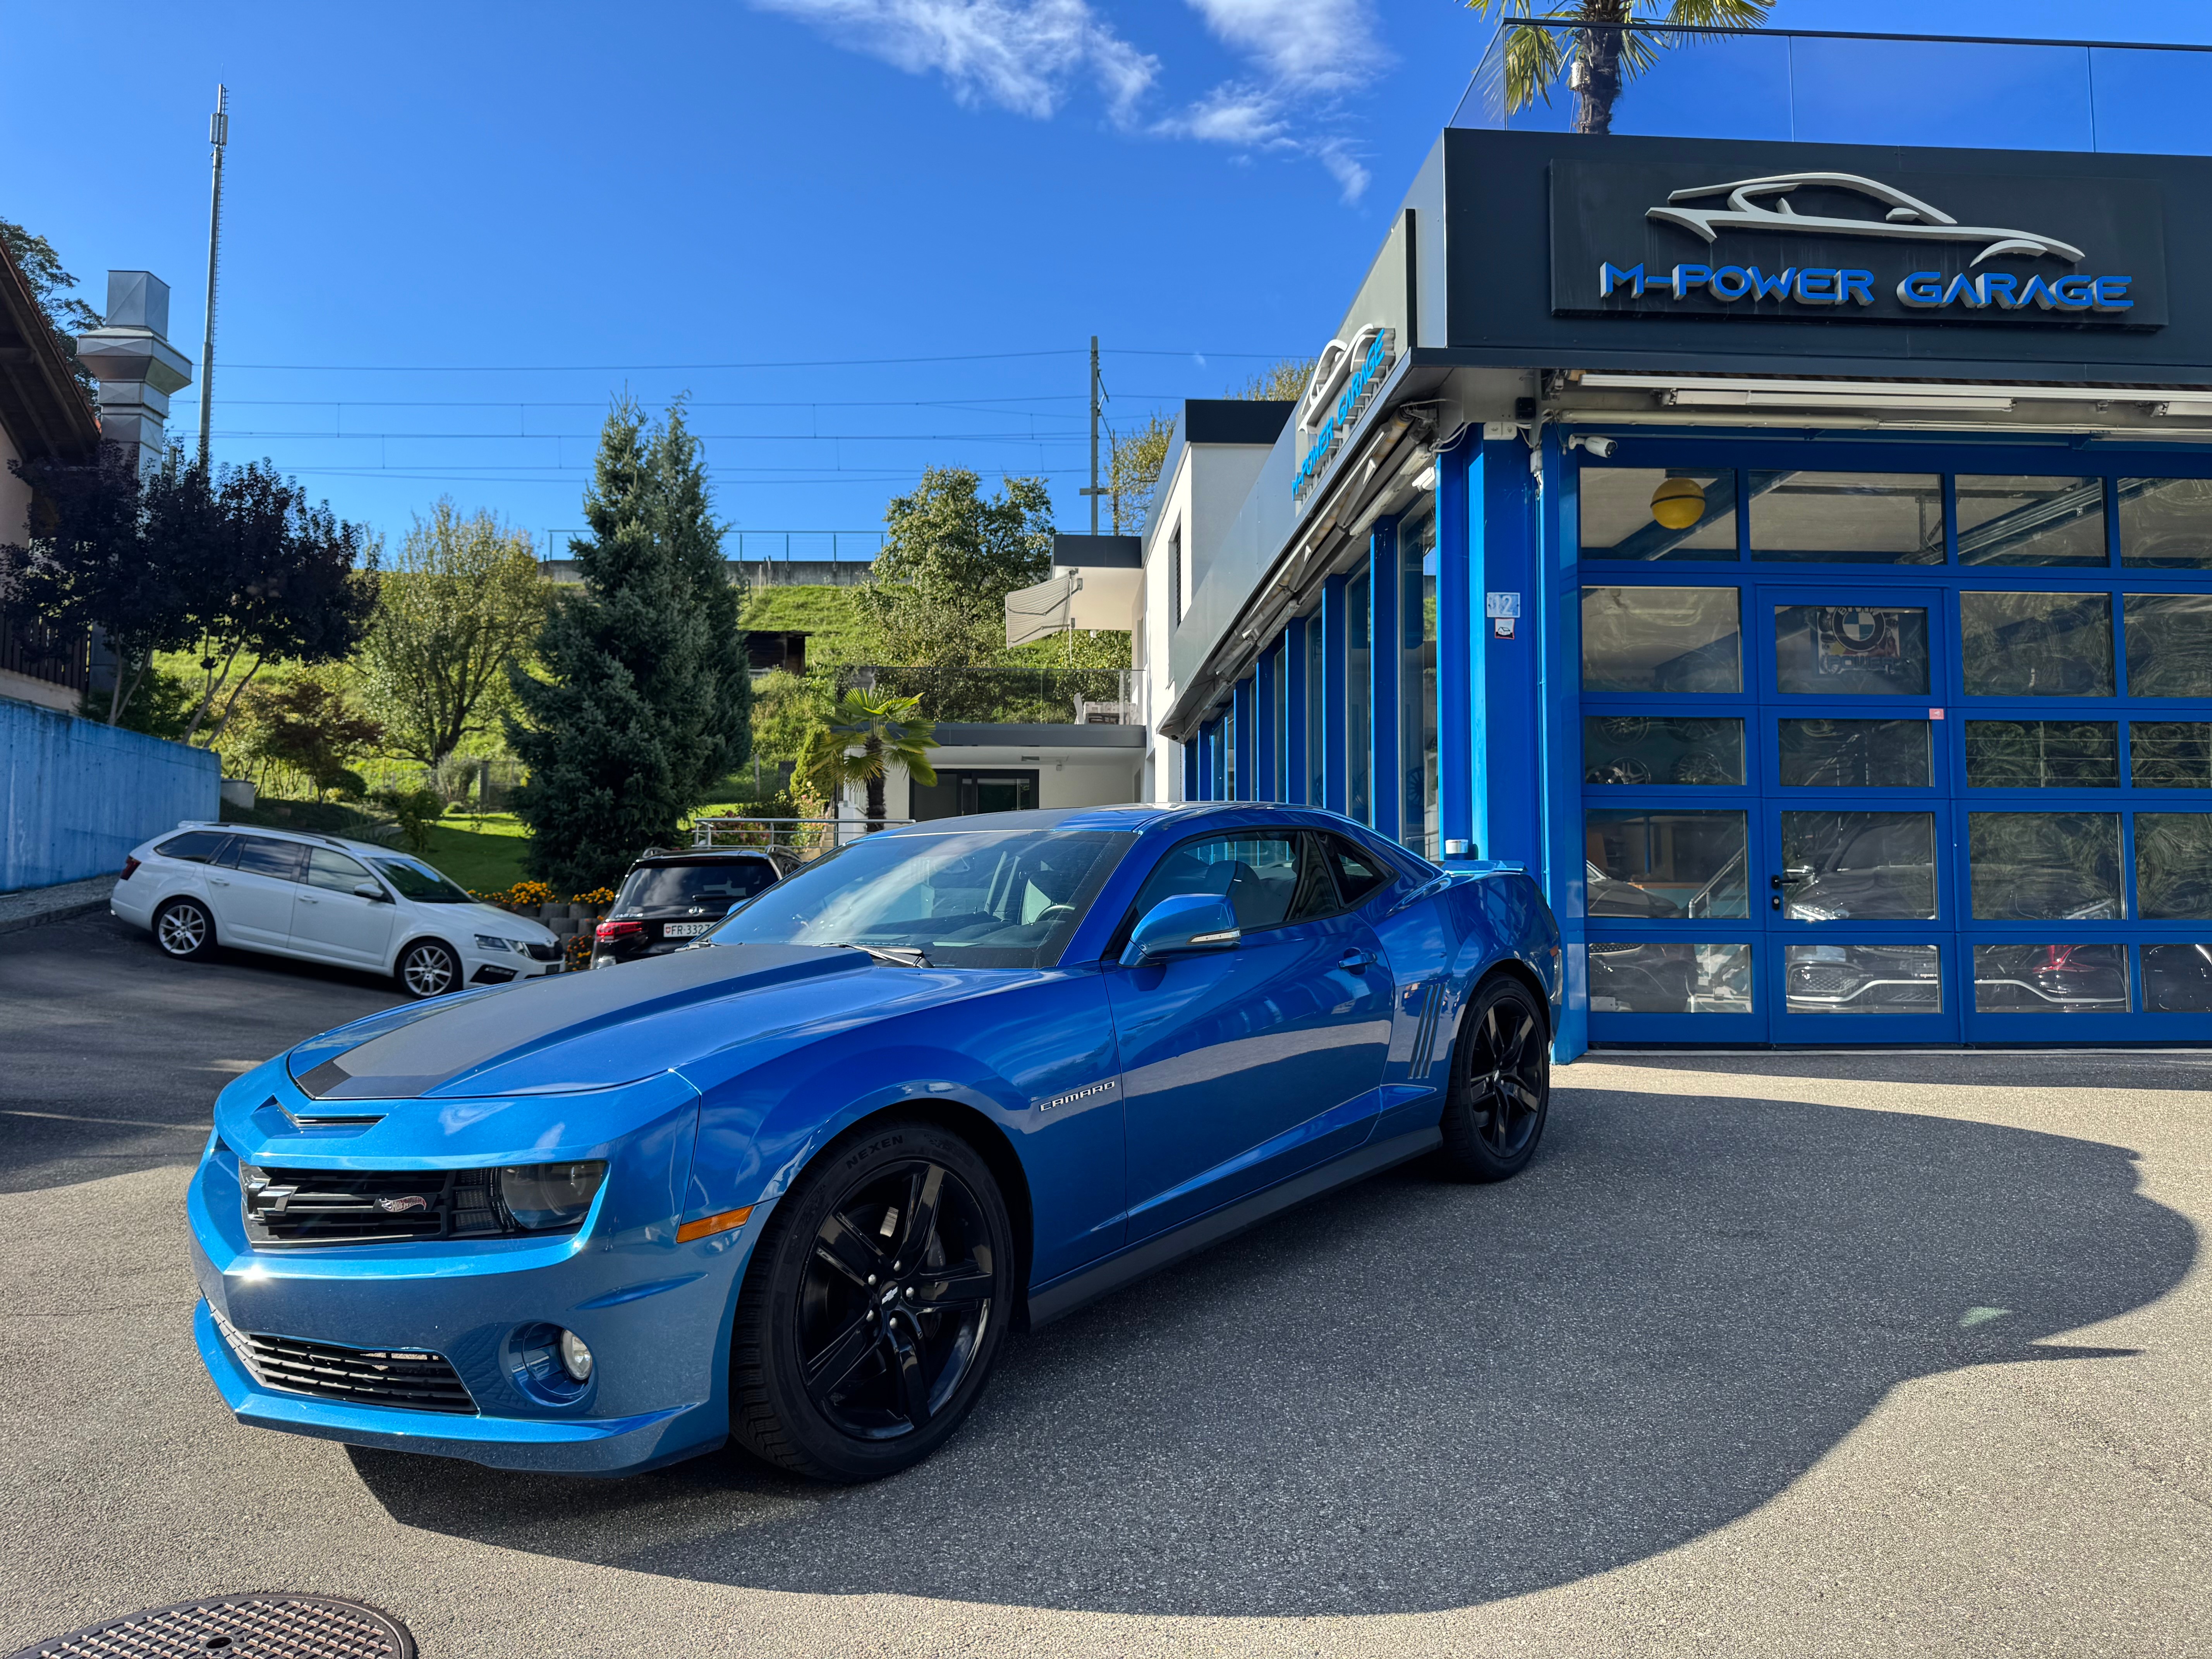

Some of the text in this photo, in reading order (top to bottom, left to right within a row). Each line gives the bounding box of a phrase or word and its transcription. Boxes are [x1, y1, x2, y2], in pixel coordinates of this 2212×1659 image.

[1601, 261, 2134, 310] M-POWER GARAGE
[1337, 328, 1385, 426] GARAGE
[1495, 595, 1513, 615] 12
[1040, 1081, 1115, 1111] CAMARO
[845, 1135, 903, 1170] NEXEN
